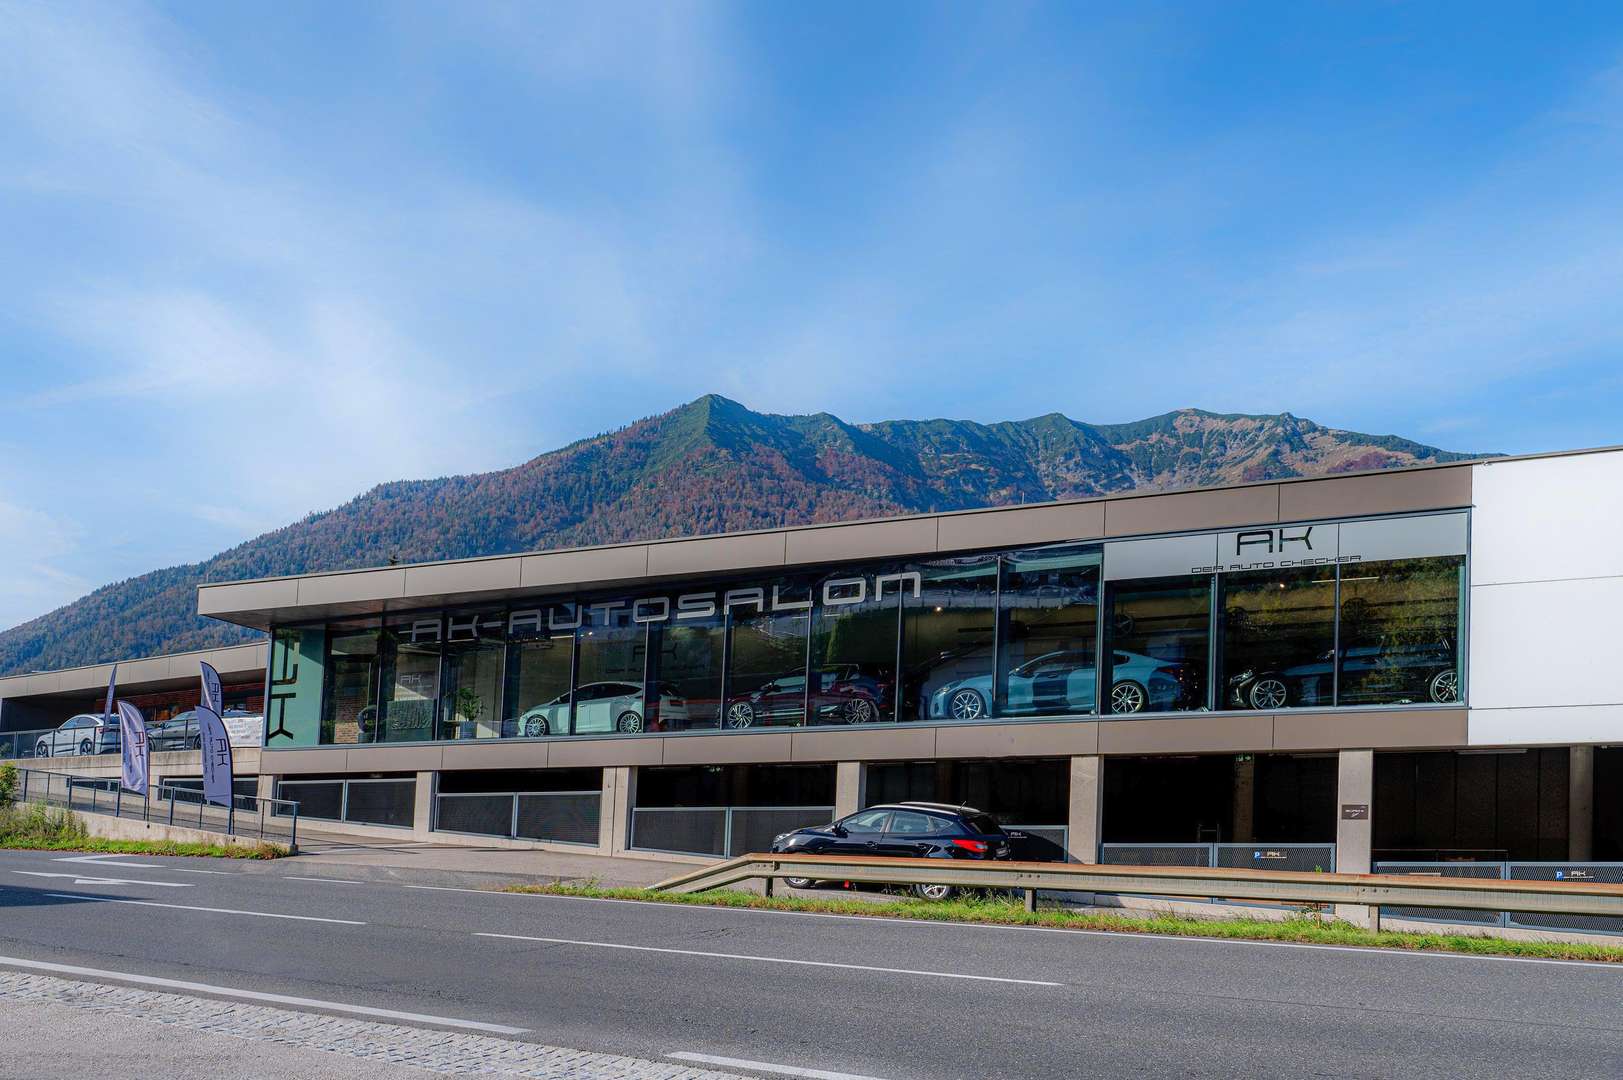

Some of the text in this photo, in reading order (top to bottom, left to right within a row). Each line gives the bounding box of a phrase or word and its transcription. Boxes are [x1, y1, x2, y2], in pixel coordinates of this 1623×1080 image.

[1236, 526, 1313, 556] AK
[1191, 554, 1362, 574] DER AUTO CHECKER
[215, 738, 228, 767] AK
